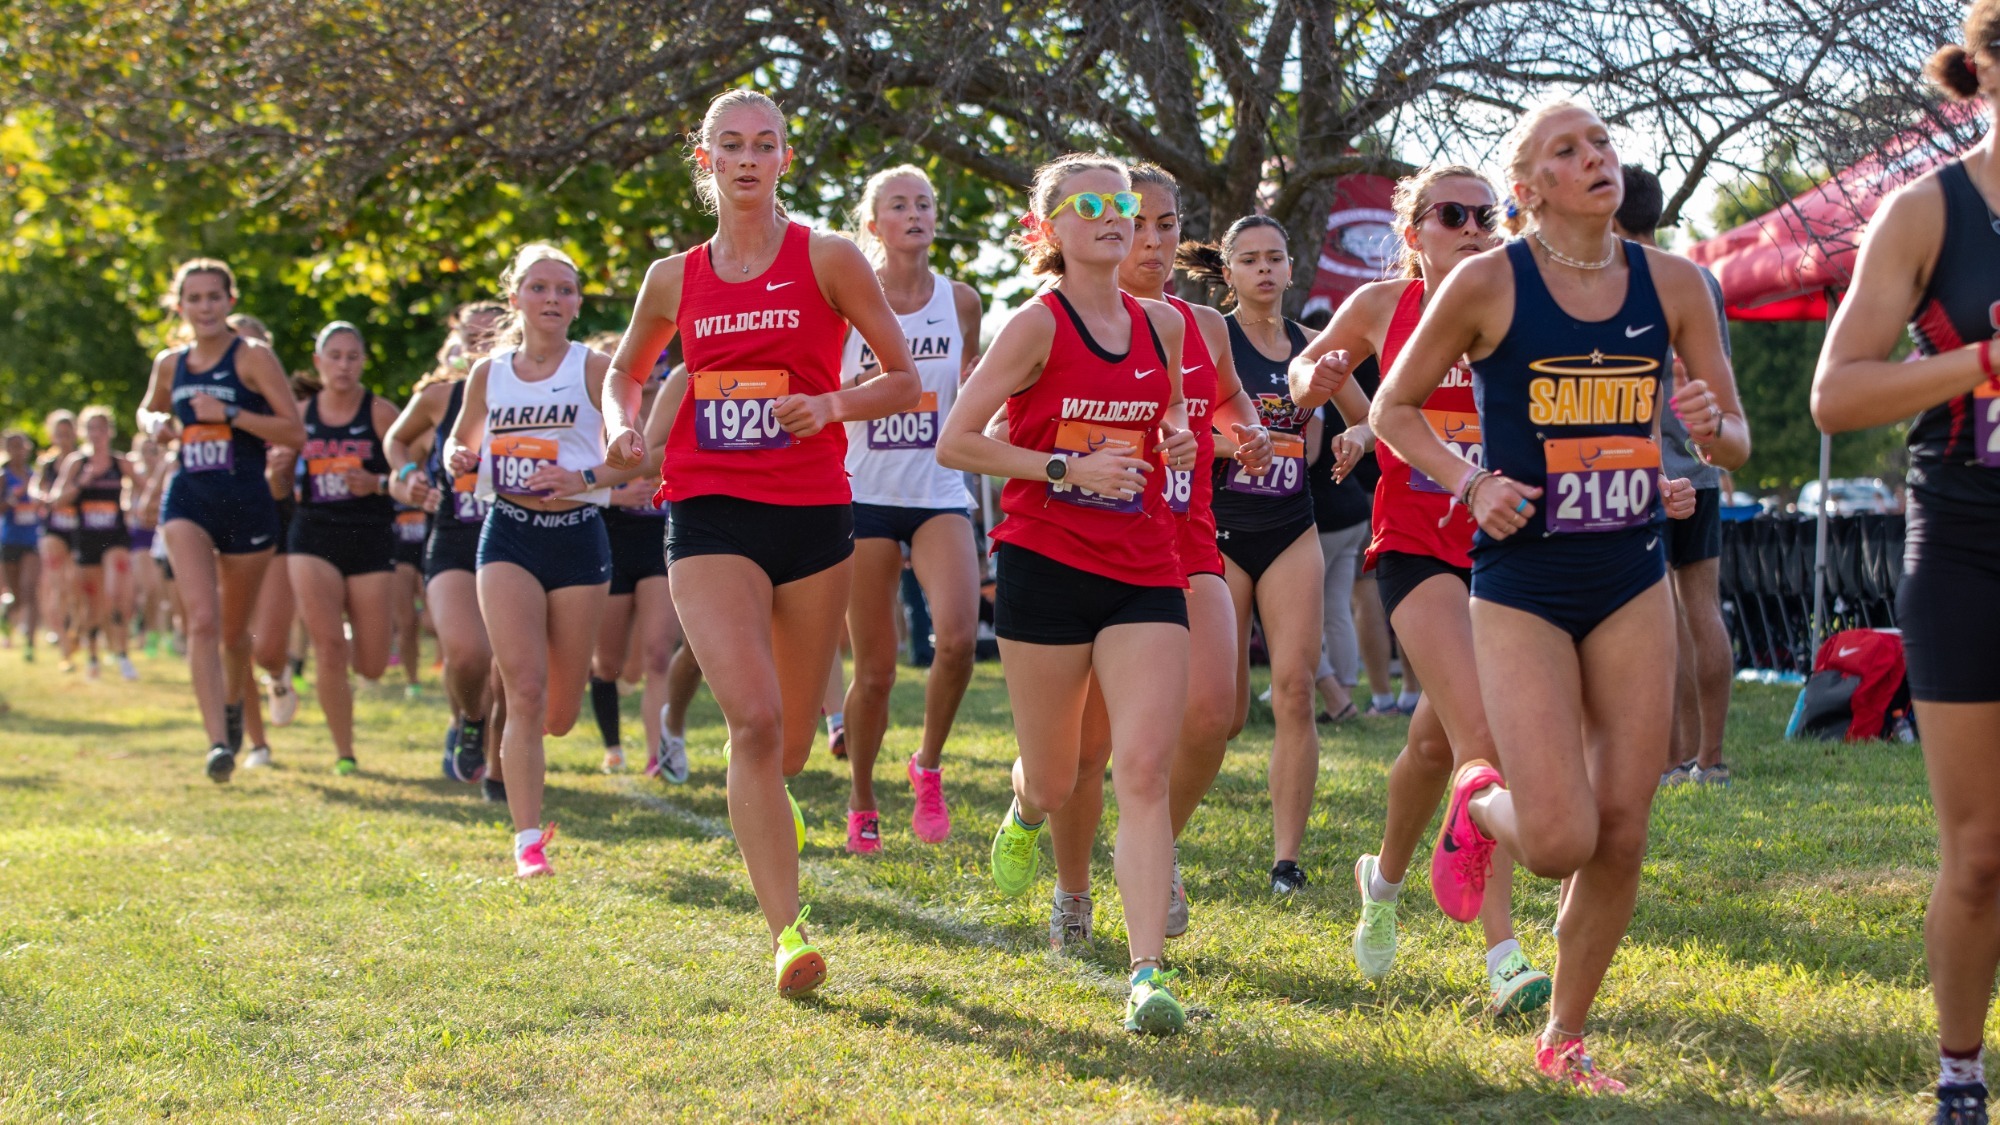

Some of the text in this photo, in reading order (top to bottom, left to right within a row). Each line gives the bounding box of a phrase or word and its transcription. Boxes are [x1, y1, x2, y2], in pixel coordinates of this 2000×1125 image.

[694, 309, 800, 339] WILDCATS
[859, 336, 951, 363] MIAN
[489, 404, 578, 427] MARIAN
[1061, 397, 1159, 422] WILDCATS
[1529, 377, 1657, 426] SAINTS
[703, 400, 781, 440] 1920
[872, 412, 933, 443] 2005
[1557, 468, 1650, 520] 2140
[494, 500, 529, 523] PRO
[532, 510, 581, 528] NIKE
